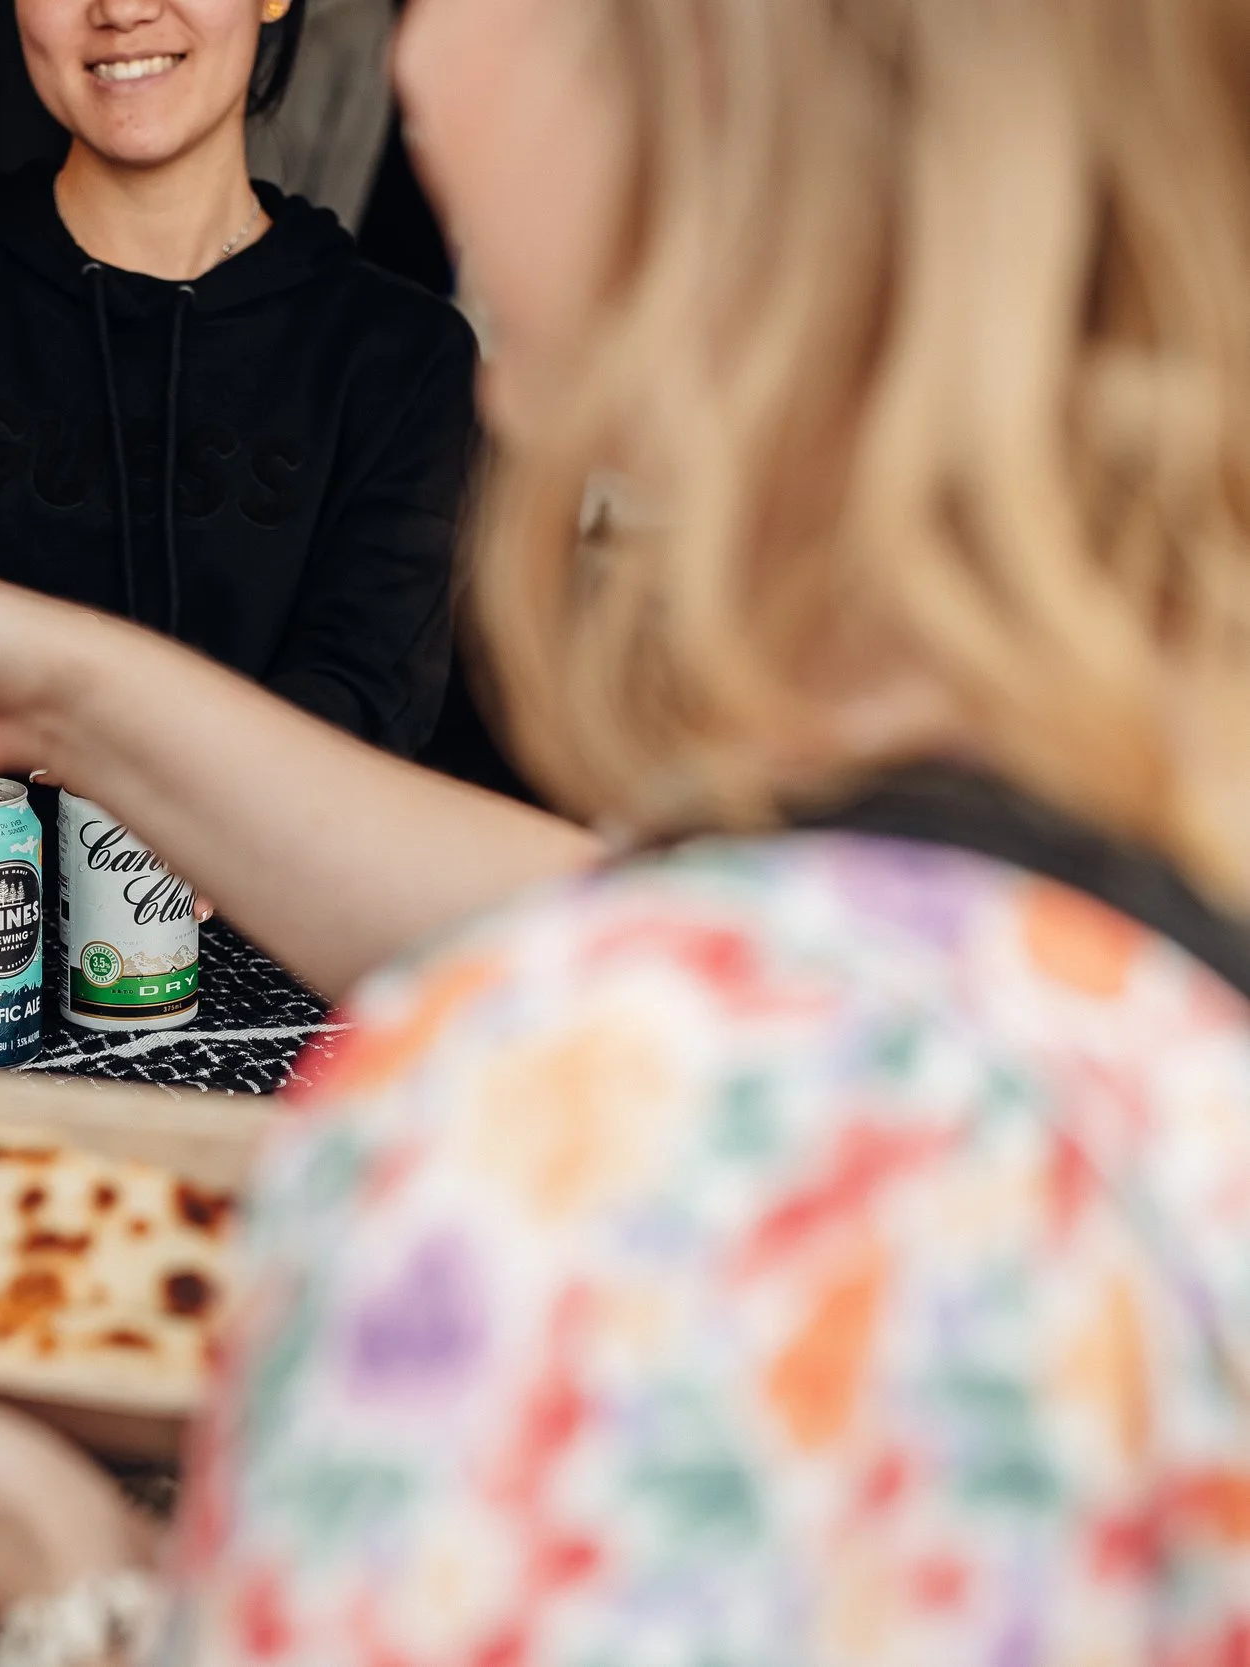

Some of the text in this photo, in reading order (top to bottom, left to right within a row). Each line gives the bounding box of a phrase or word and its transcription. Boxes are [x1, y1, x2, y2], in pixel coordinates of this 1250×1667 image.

[11, 819, 23, 827] EVER
[8, 824, 28, 835] SUNSET?
[92, 956, 111, 968] 3.5%
[139, 973, 195, 996] DRY
[24, 996, 40, 1018] ALE
